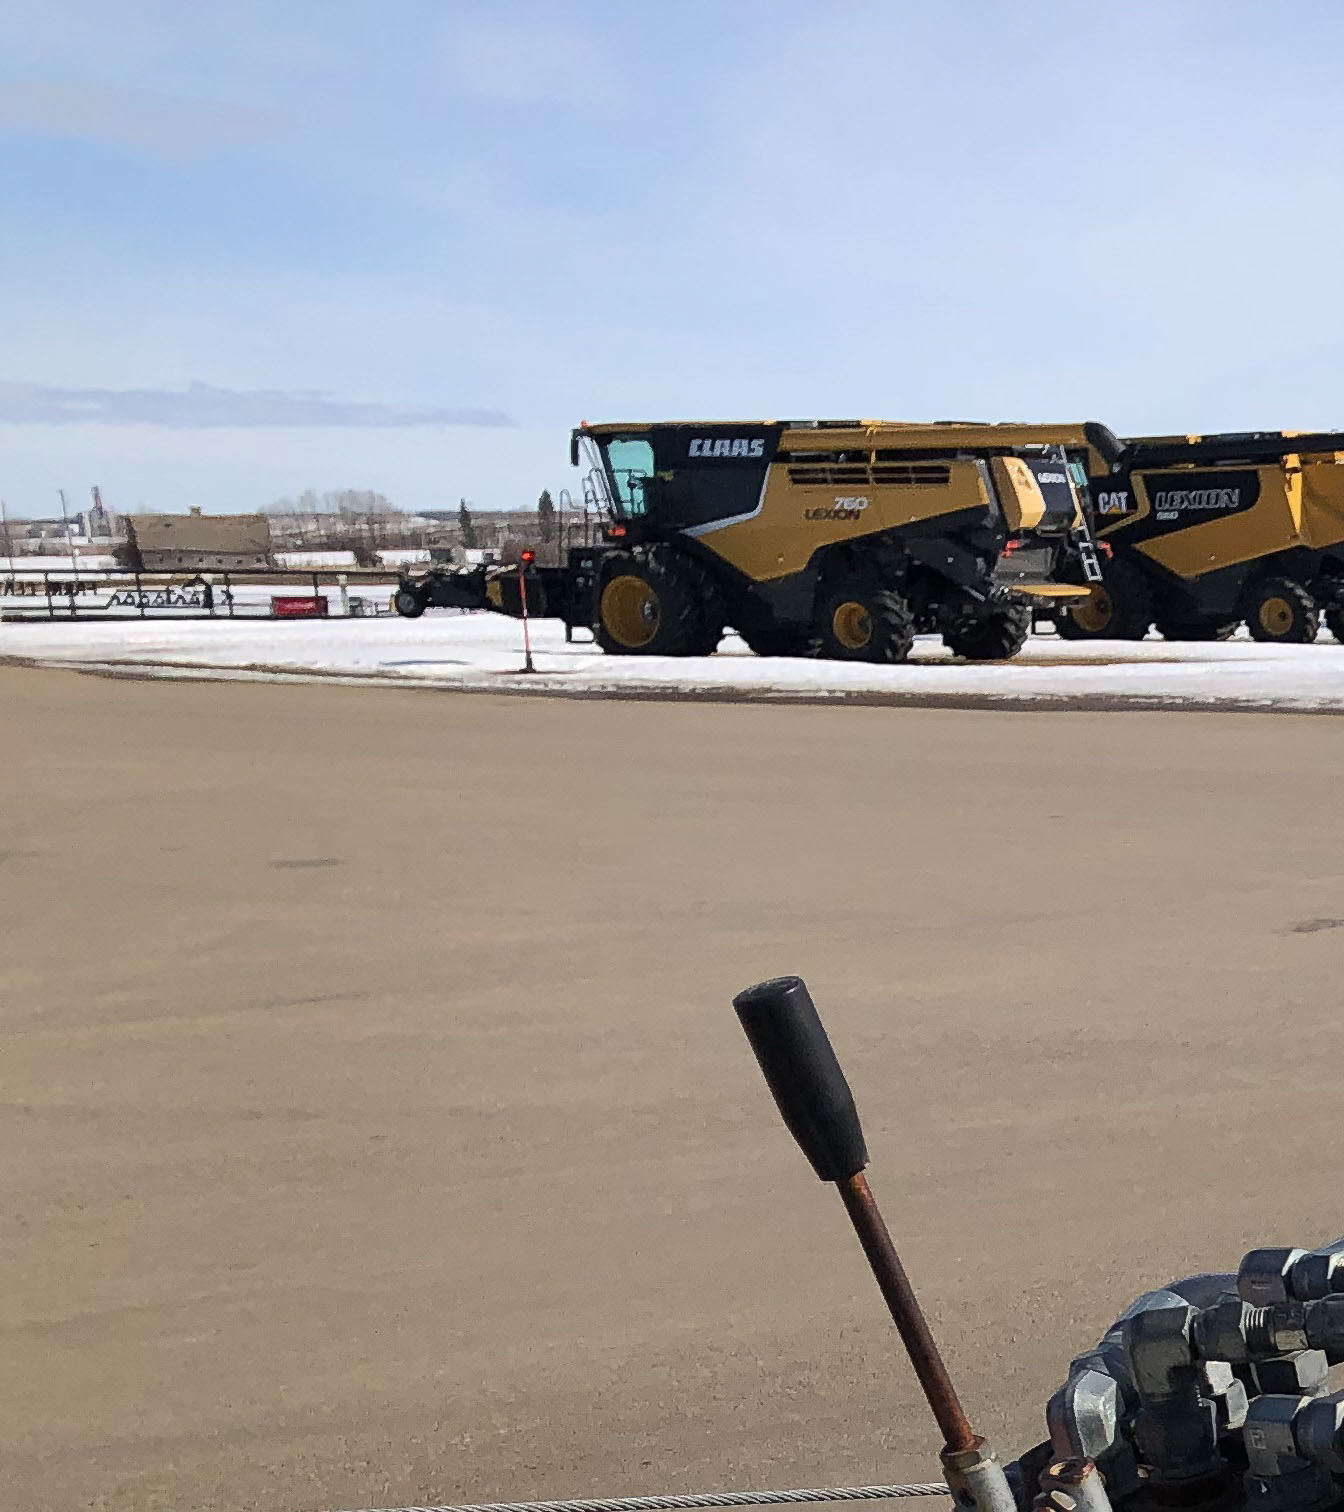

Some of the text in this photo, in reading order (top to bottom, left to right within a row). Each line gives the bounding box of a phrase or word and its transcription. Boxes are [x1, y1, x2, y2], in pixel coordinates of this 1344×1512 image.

[688, 438, 765, 458] CLAAS
[1099, 491, 1128, 513] CAT
[1155, 488, 1240, 511] LEXION
[804, 508, 861, 521] LEXION
